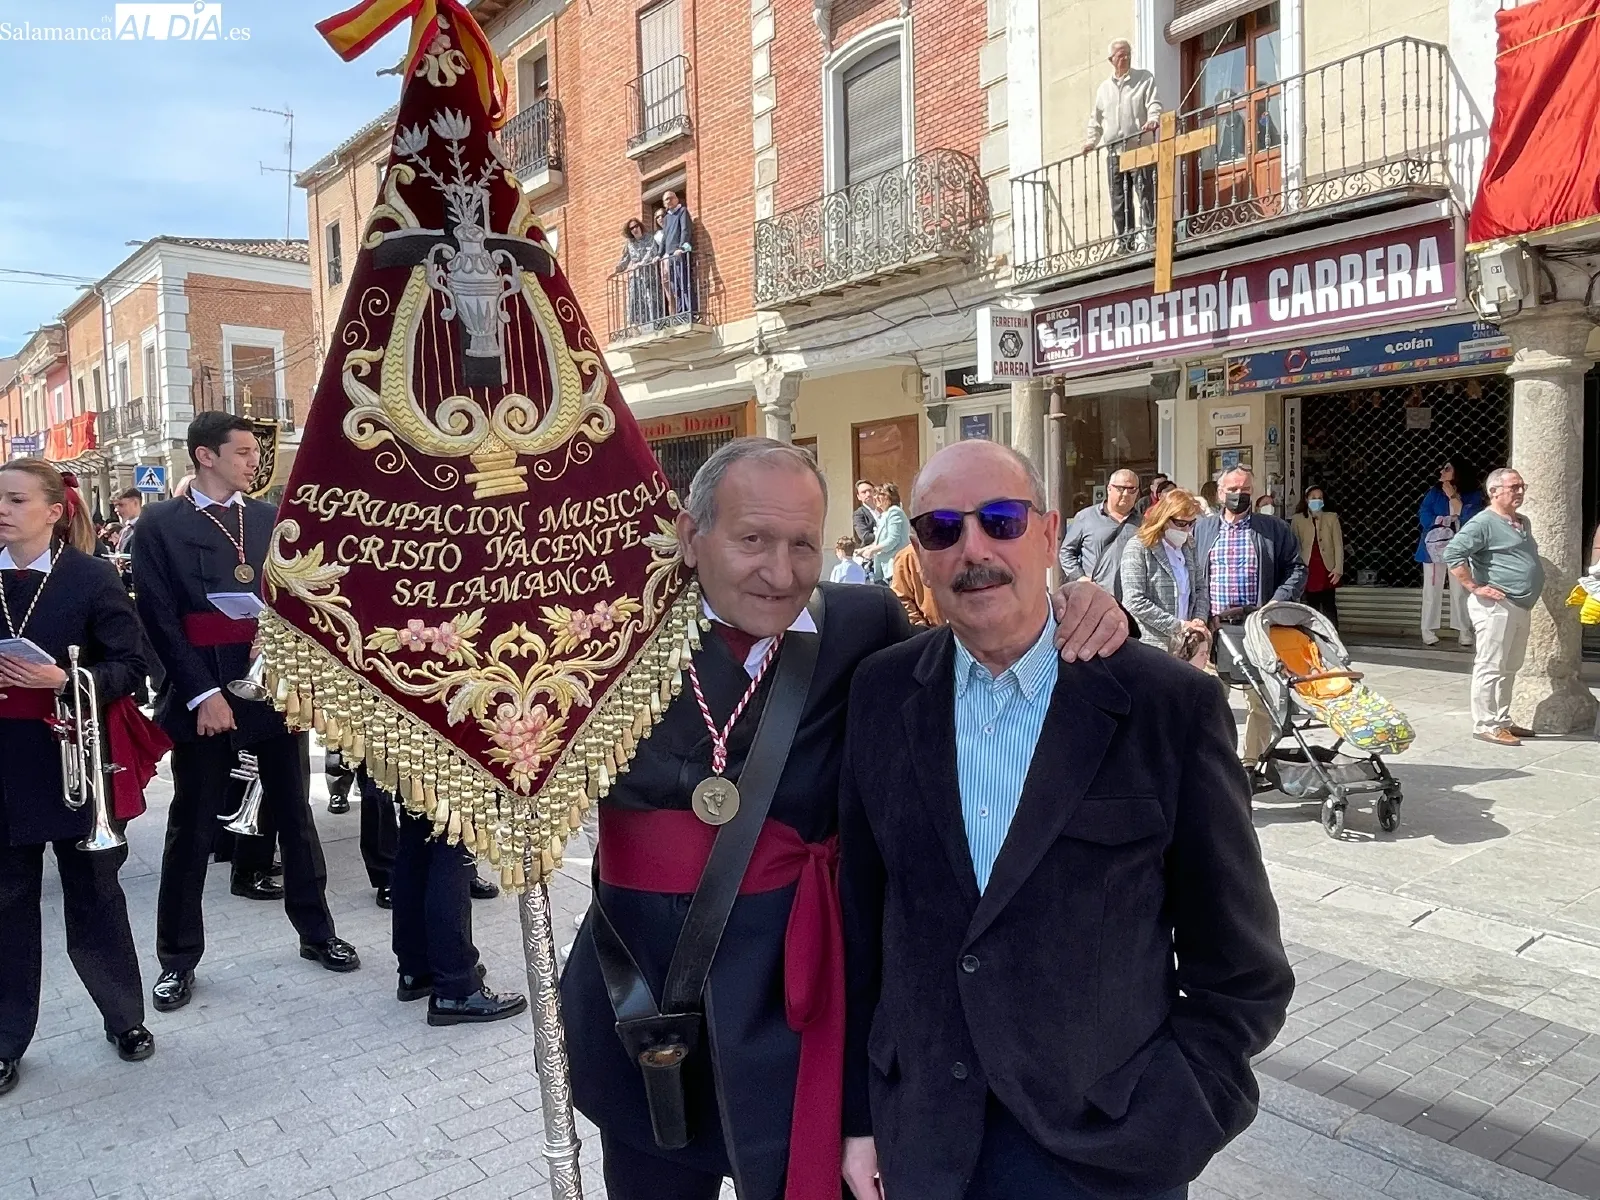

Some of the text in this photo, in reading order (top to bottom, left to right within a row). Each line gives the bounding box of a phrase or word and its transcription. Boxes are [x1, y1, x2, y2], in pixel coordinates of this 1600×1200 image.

[1087, 236, 1444, 354] FERRETERÍA CARRERA
[1046, 309, 1070, 321] BRICO
[1043, 348, 1075, 361] MENAJE
[1395, 337, 1434, 351] cofan
[993, 361, 1030, 376] CARRERA
[289, 471, 668, 536] AGRUPACION MUSICAL
[337, 520, 641, 573] CRISTO YACENTE
[391, 560, 616, 609] SALAMANCA
